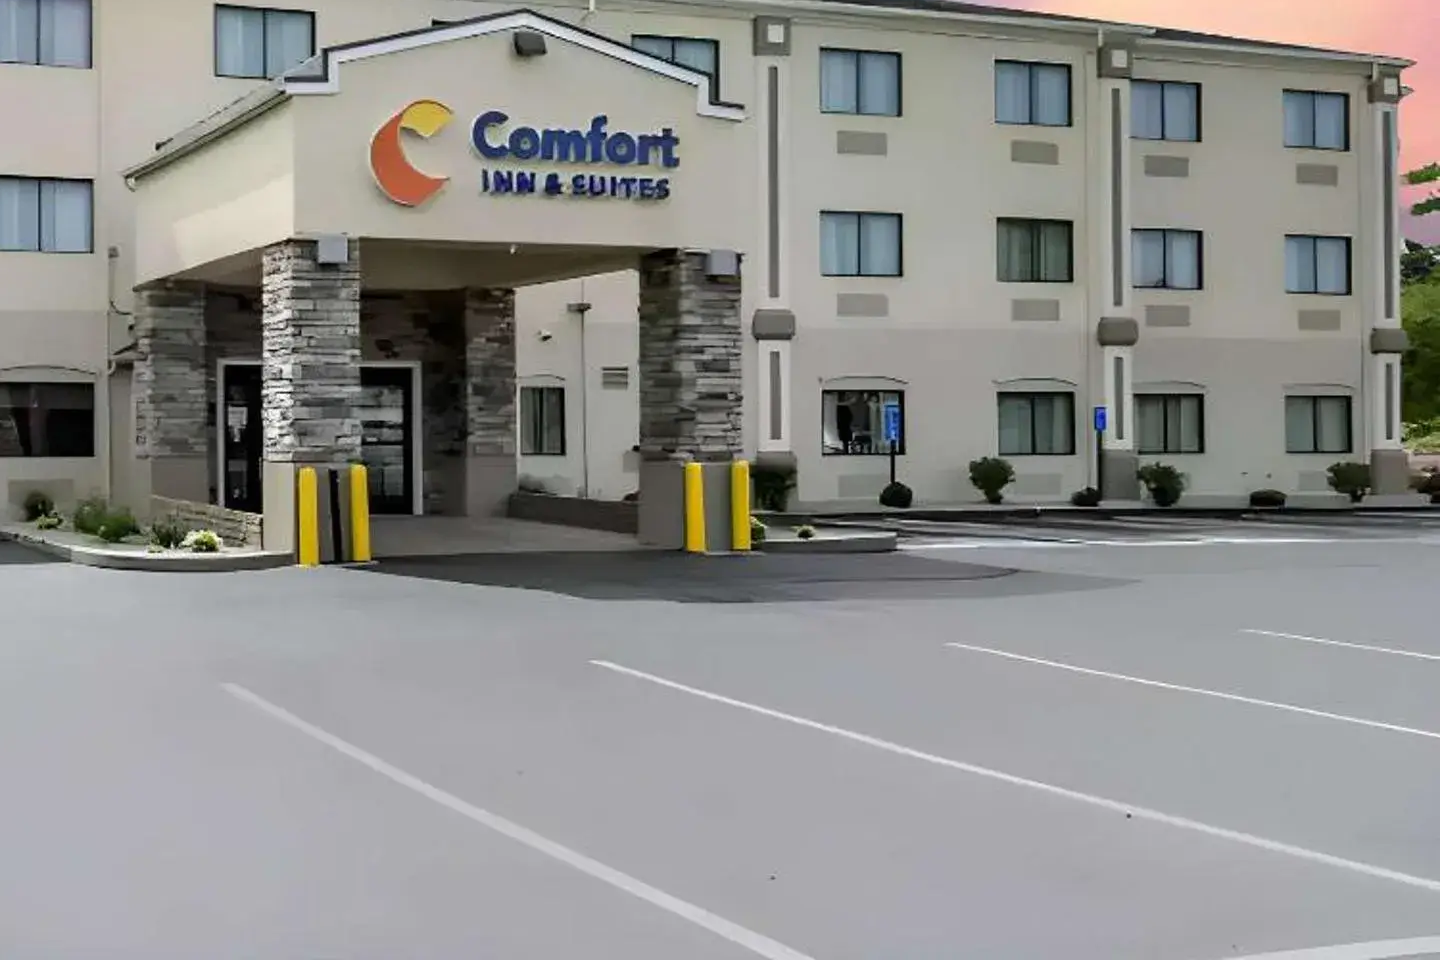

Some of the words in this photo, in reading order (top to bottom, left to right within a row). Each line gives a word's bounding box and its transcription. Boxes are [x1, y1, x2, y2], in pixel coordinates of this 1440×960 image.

[471, 110, 680, 168] Comfort
[481, 169, 536, 194] INN
[544, 174, 564, 195] &
[571, 174, 671, 201] SUITES
